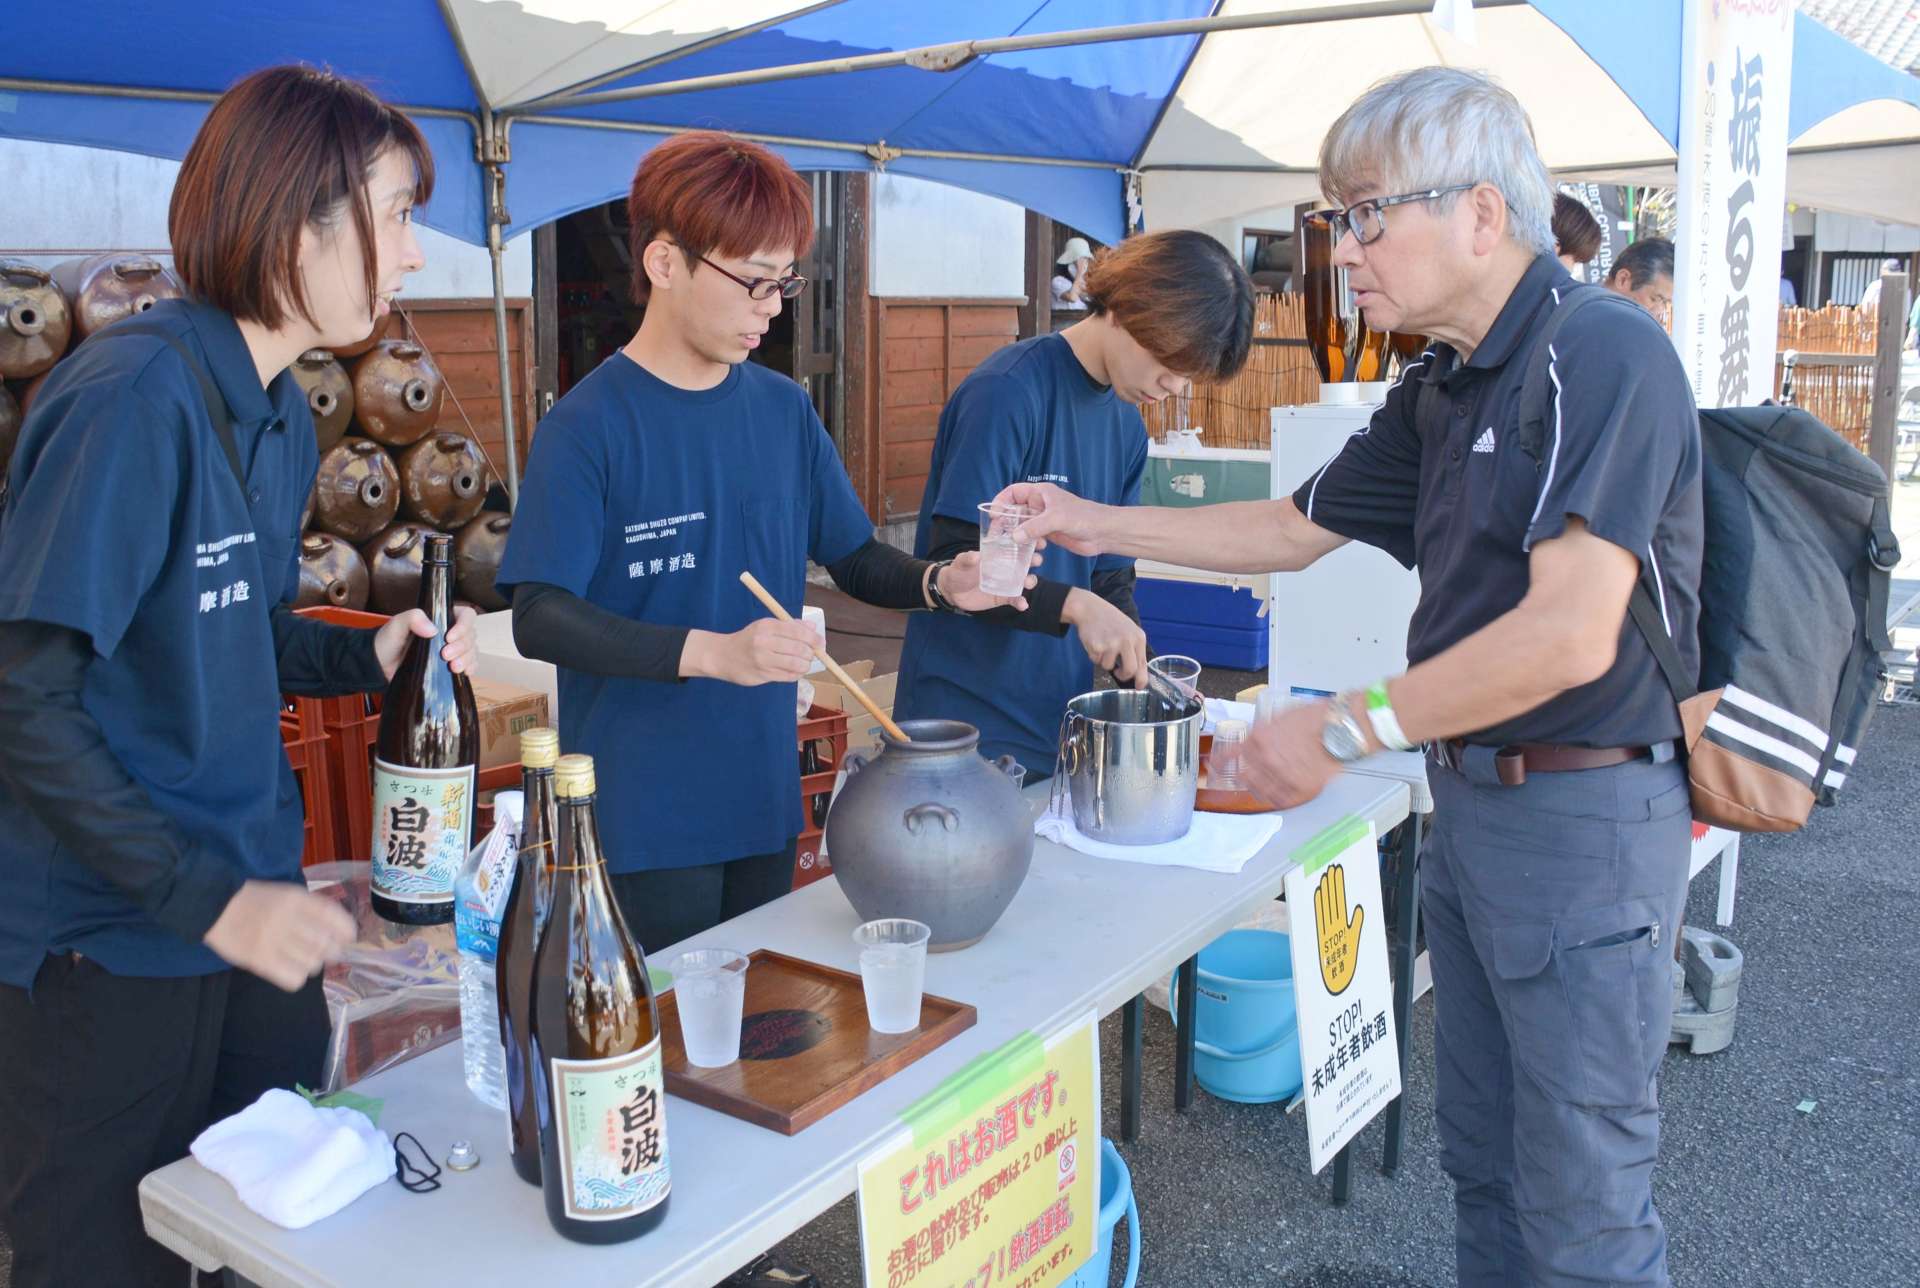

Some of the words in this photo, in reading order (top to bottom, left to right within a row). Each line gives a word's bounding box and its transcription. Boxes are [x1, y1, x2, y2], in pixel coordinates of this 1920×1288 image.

[628, 552, 695, 578] 薩摩酒造
[385, 796, 430, 870] 白波
[1324, 928, 1346, 953] STOP!
[1312, 1010, 1387, 1098] 未成年者飲酒
[1329, 998, 1363, 1047] STOP!
[619, 1085, 661, 1176] 白波
[900, 1070, 1068, 1215] これはお酒です。
